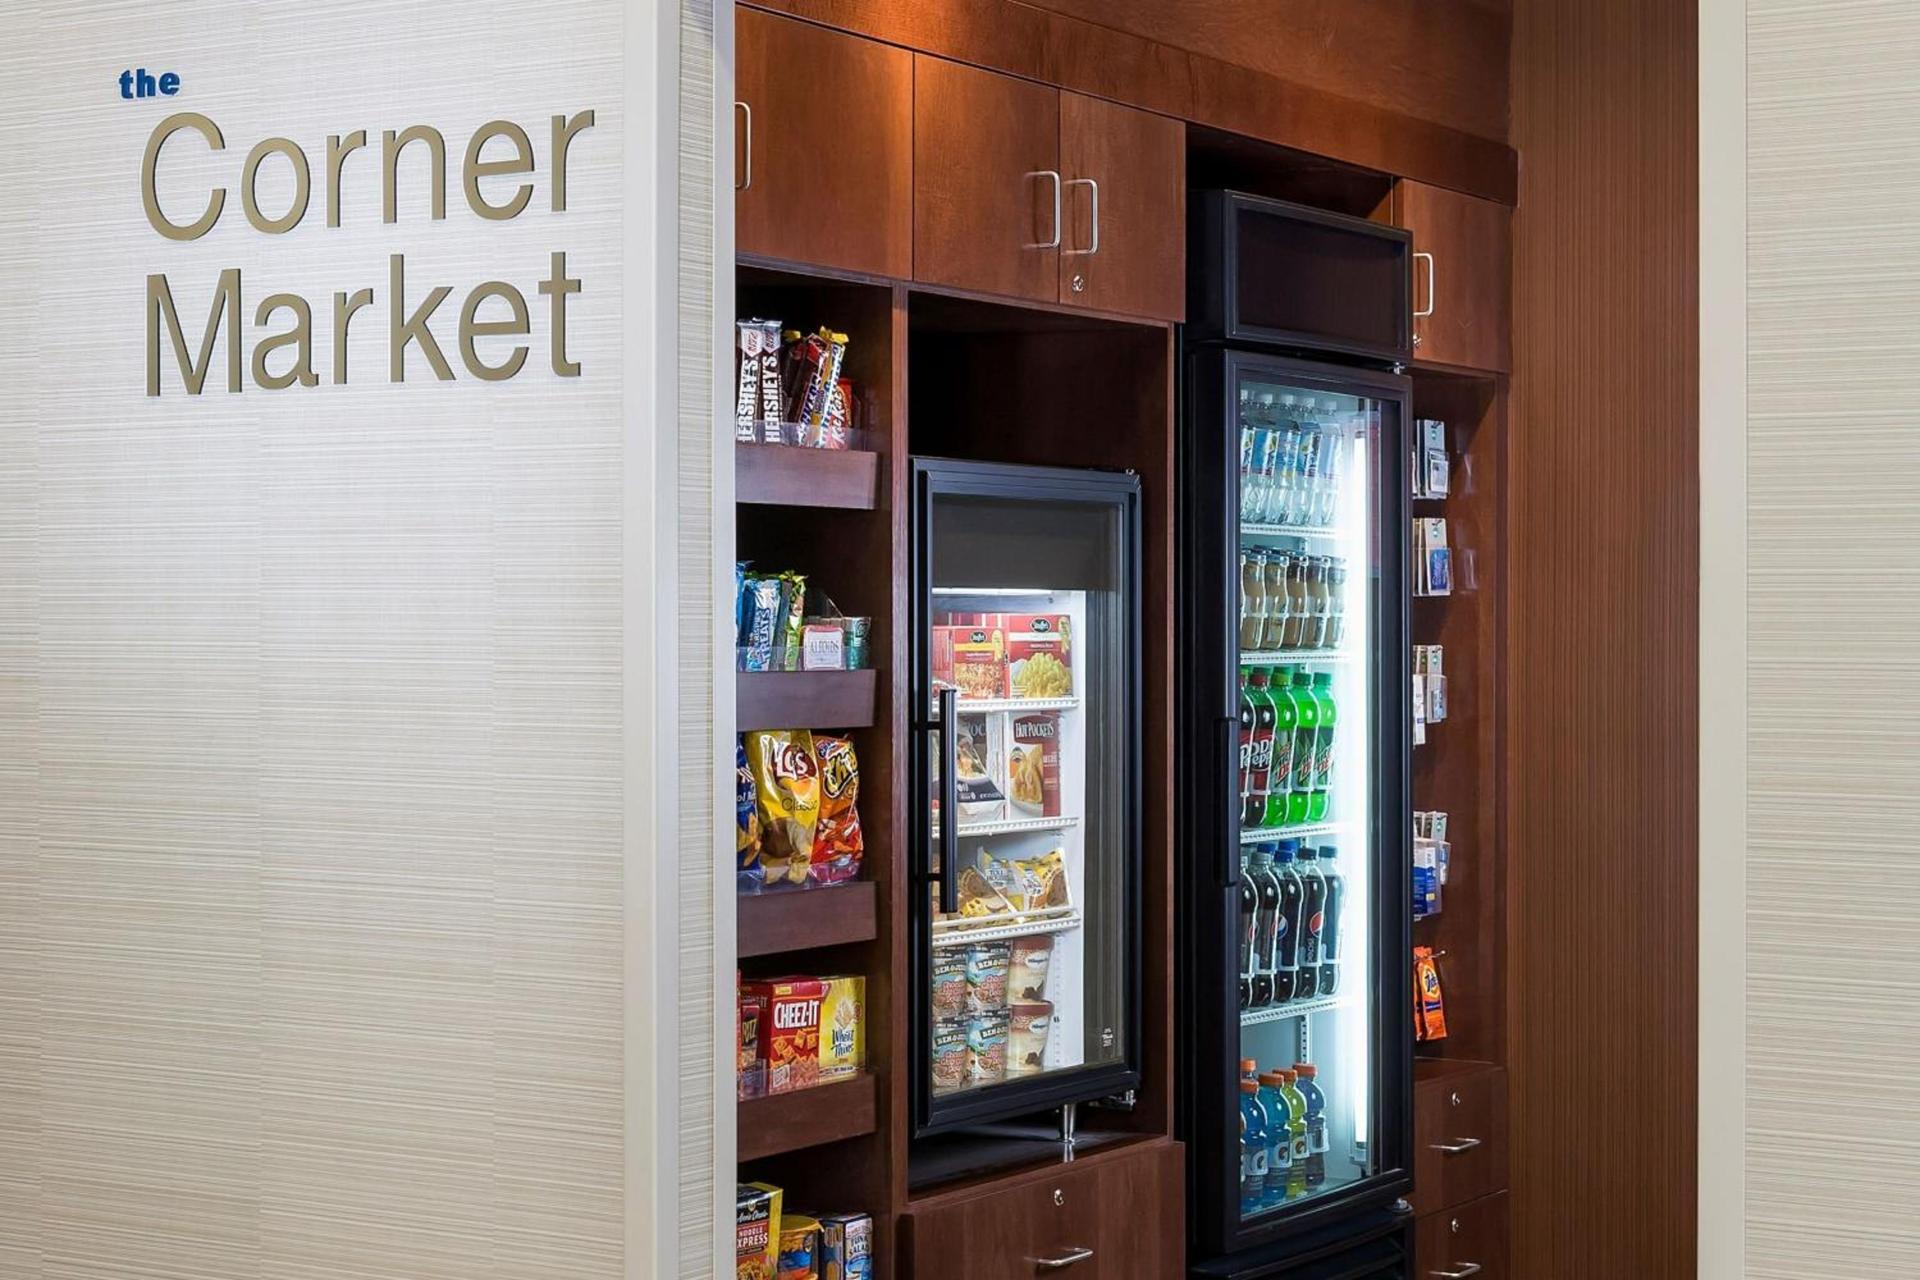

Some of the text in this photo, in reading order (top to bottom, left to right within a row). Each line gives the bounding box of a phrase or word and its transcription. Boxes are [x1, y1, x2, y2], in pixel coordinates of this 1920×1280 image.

[119, 68, 180, 98] the
[141, 110, 595, 241] Corner
[146, 251, 582, 397] Market
[763, 355, 780, 443] HERSHEY'S
[758, 607, 772, 663] TREATS
[773, 999, 819, 1029] CHEEZ-IT
[736, 1233, 768, 1249] XPRESS
